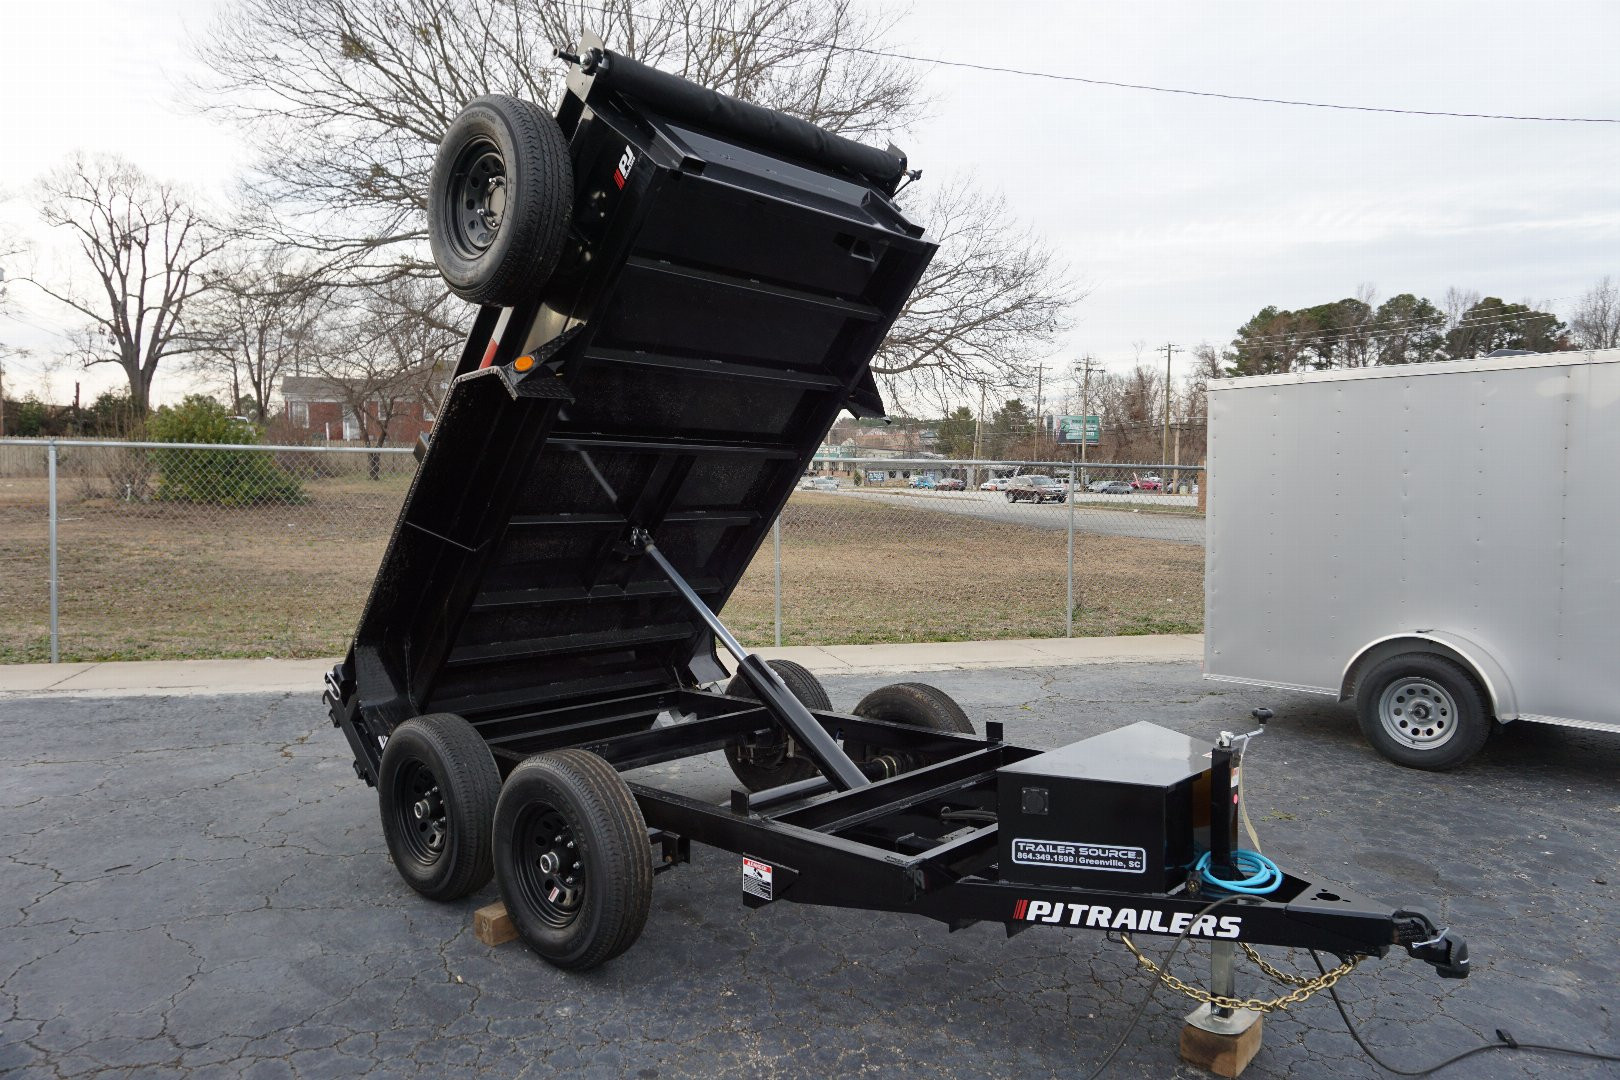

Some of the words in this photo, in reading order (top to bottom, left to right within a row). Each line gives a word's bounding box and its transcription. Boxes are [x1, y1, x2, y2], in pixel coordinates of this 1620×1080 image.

[1017, 842, 1076, 855] TRAILER
[1078, 847, 1137, 859] SOURCE
[1079, 857, 1126, 868] Greenville,
[1067, 904, 1243, 938] TRAILERS
